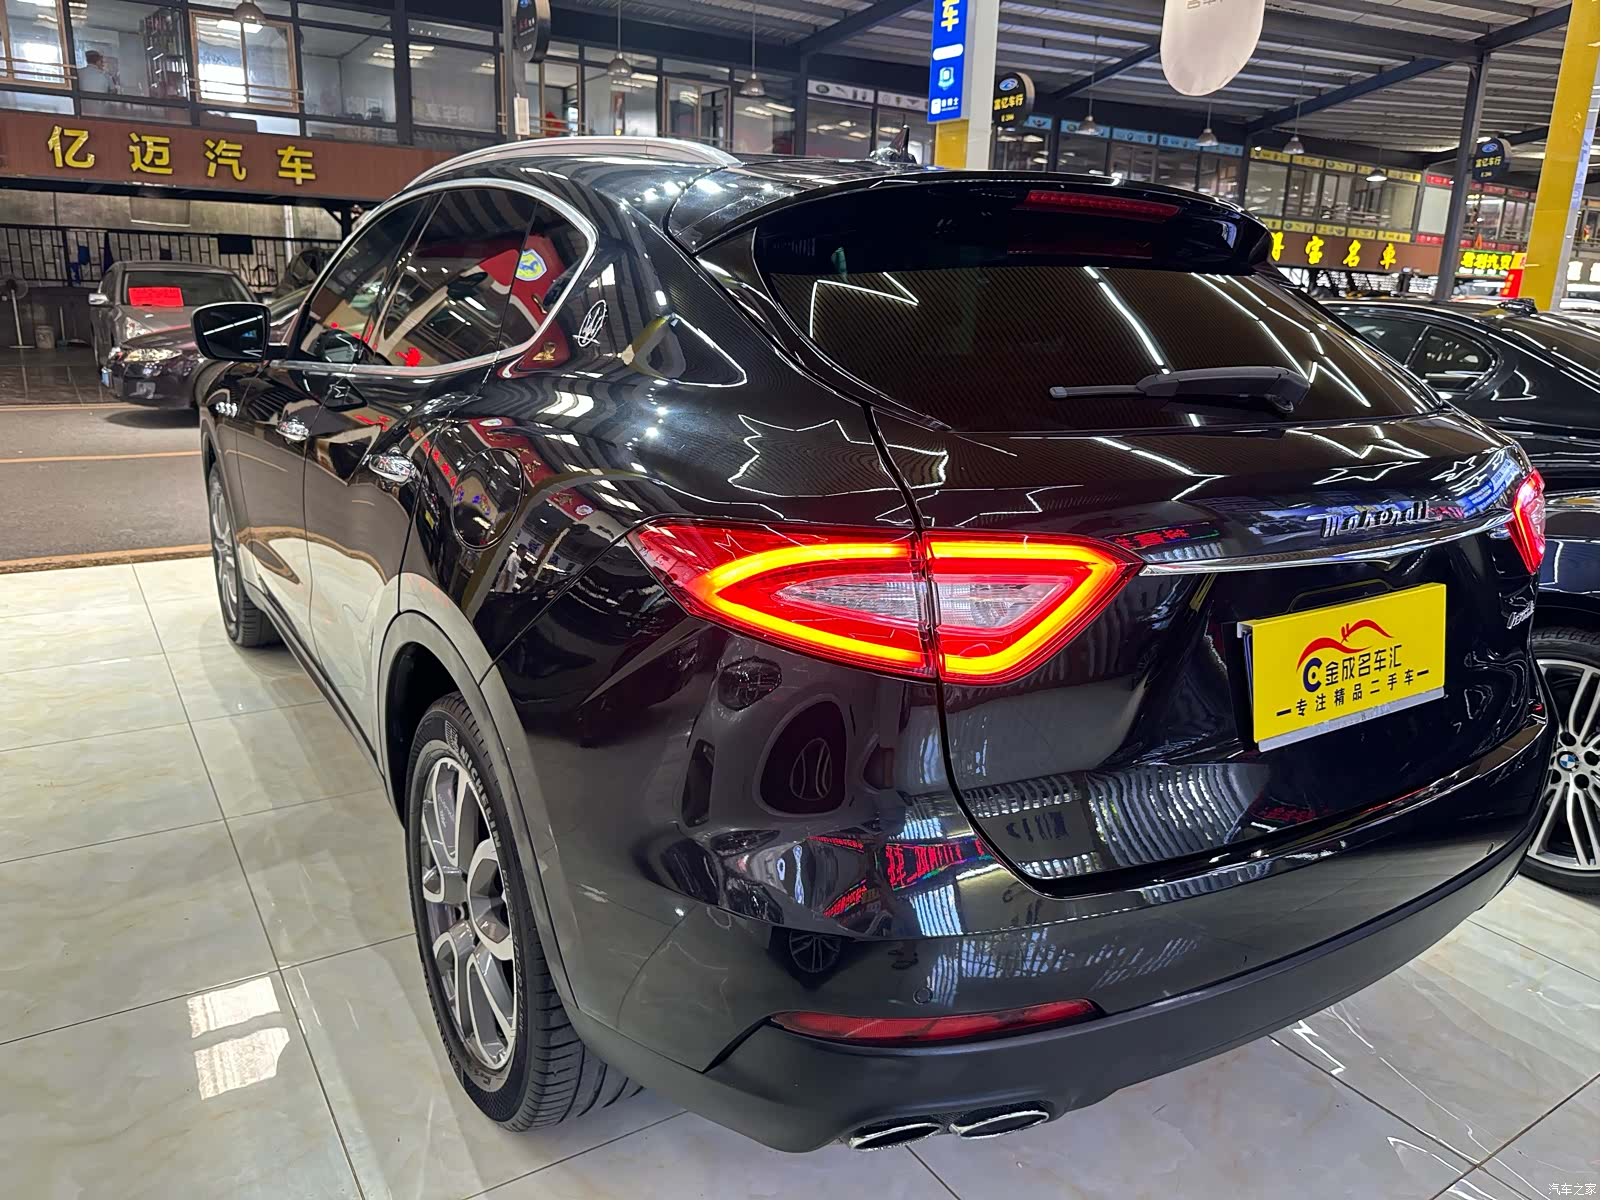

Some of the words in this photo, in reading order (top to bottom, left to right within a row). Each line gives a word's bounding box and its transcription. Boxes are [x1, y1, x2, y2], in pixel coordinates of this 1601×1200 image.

[47, 125, 316, 185] 亿迈汽车
[1325, 644, 1402, 686] 金成名车汇
[1295, 669, 1414, 717] 专注精品二手车
[460, 745, 501, 848] MICHELIN
